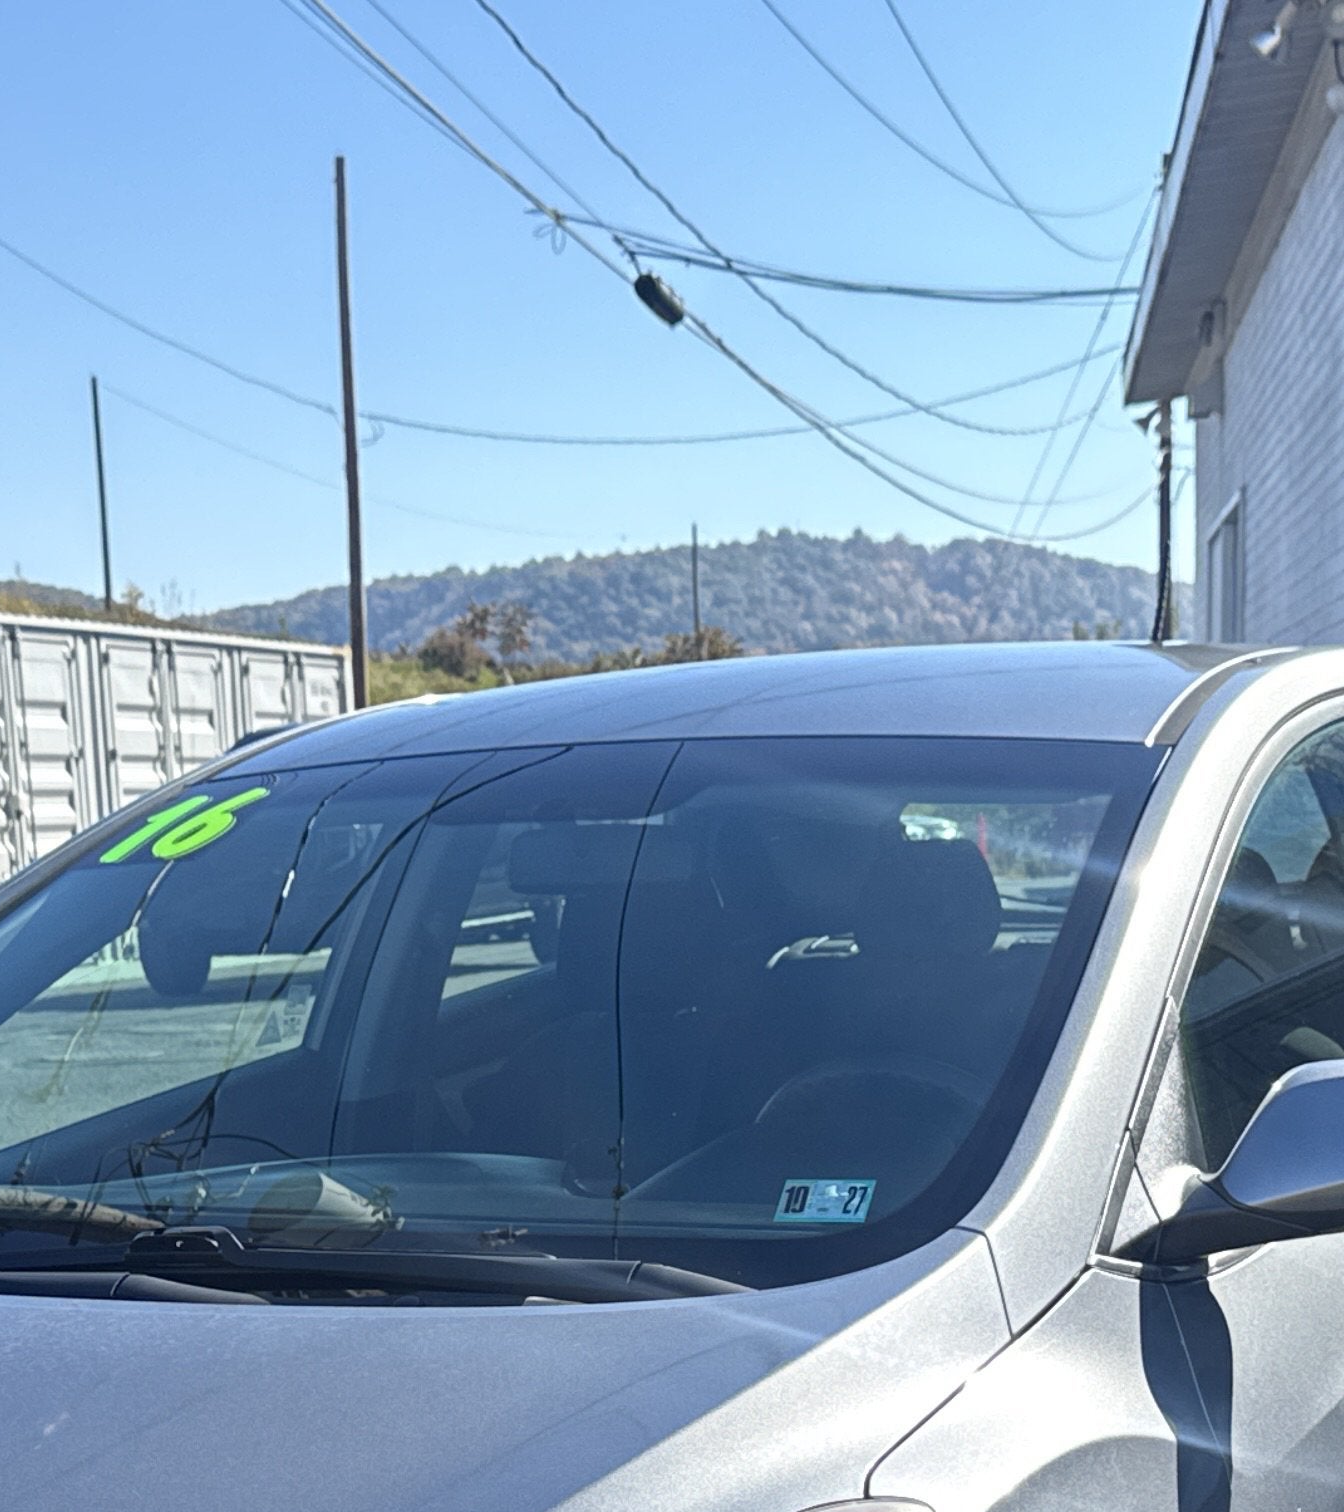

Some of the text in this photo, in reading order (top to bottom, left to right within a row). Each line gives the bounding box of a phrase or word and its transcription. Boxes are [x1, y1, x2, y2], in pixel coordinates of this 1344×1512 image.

[99, 787, 271, 864] 16
[783, 1186, 869, 1216] 10 27
